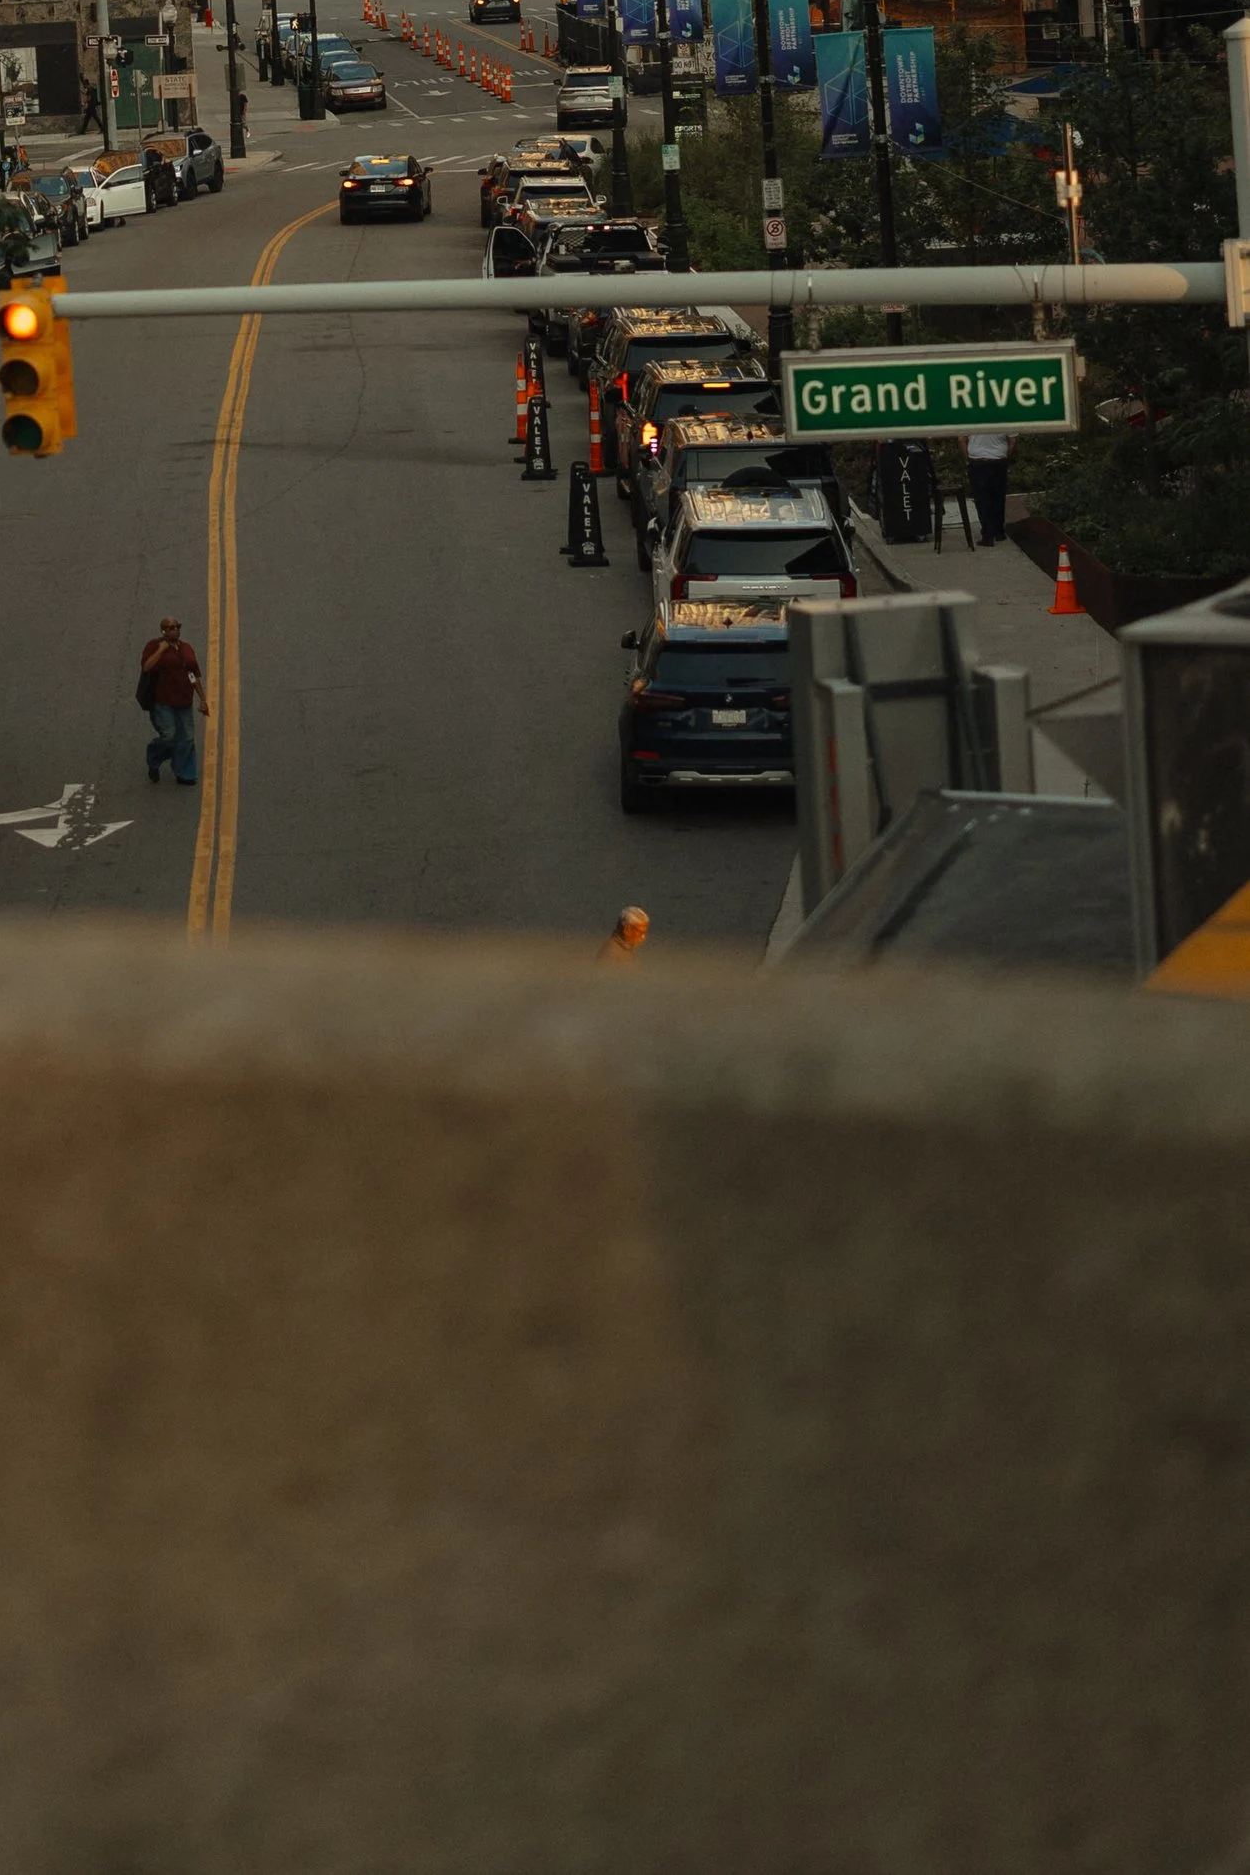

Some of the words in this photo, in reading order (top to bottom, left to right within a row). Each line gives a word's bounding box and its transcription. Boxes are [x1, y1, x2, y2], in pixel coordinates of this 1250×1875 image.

[778, 9, 787, 51] DOWNTOWN
[784, 23, 792, 51] DETROIT
[789, 7, 798, 50] PARTNERSHIP
[896, 54, 907, 104] DOWNTOWN
[905, 71, 913, 104] DETROIT
[910, 51, 920, 103] PARTNERSHIP
[801, 373, 927, 416] Grand
[949, 369, 1057, 410] River
[533, 405, 542, 456] VALET
[582, 482, 591, 539] VALET
[898, 455, 913, 522] VALET
